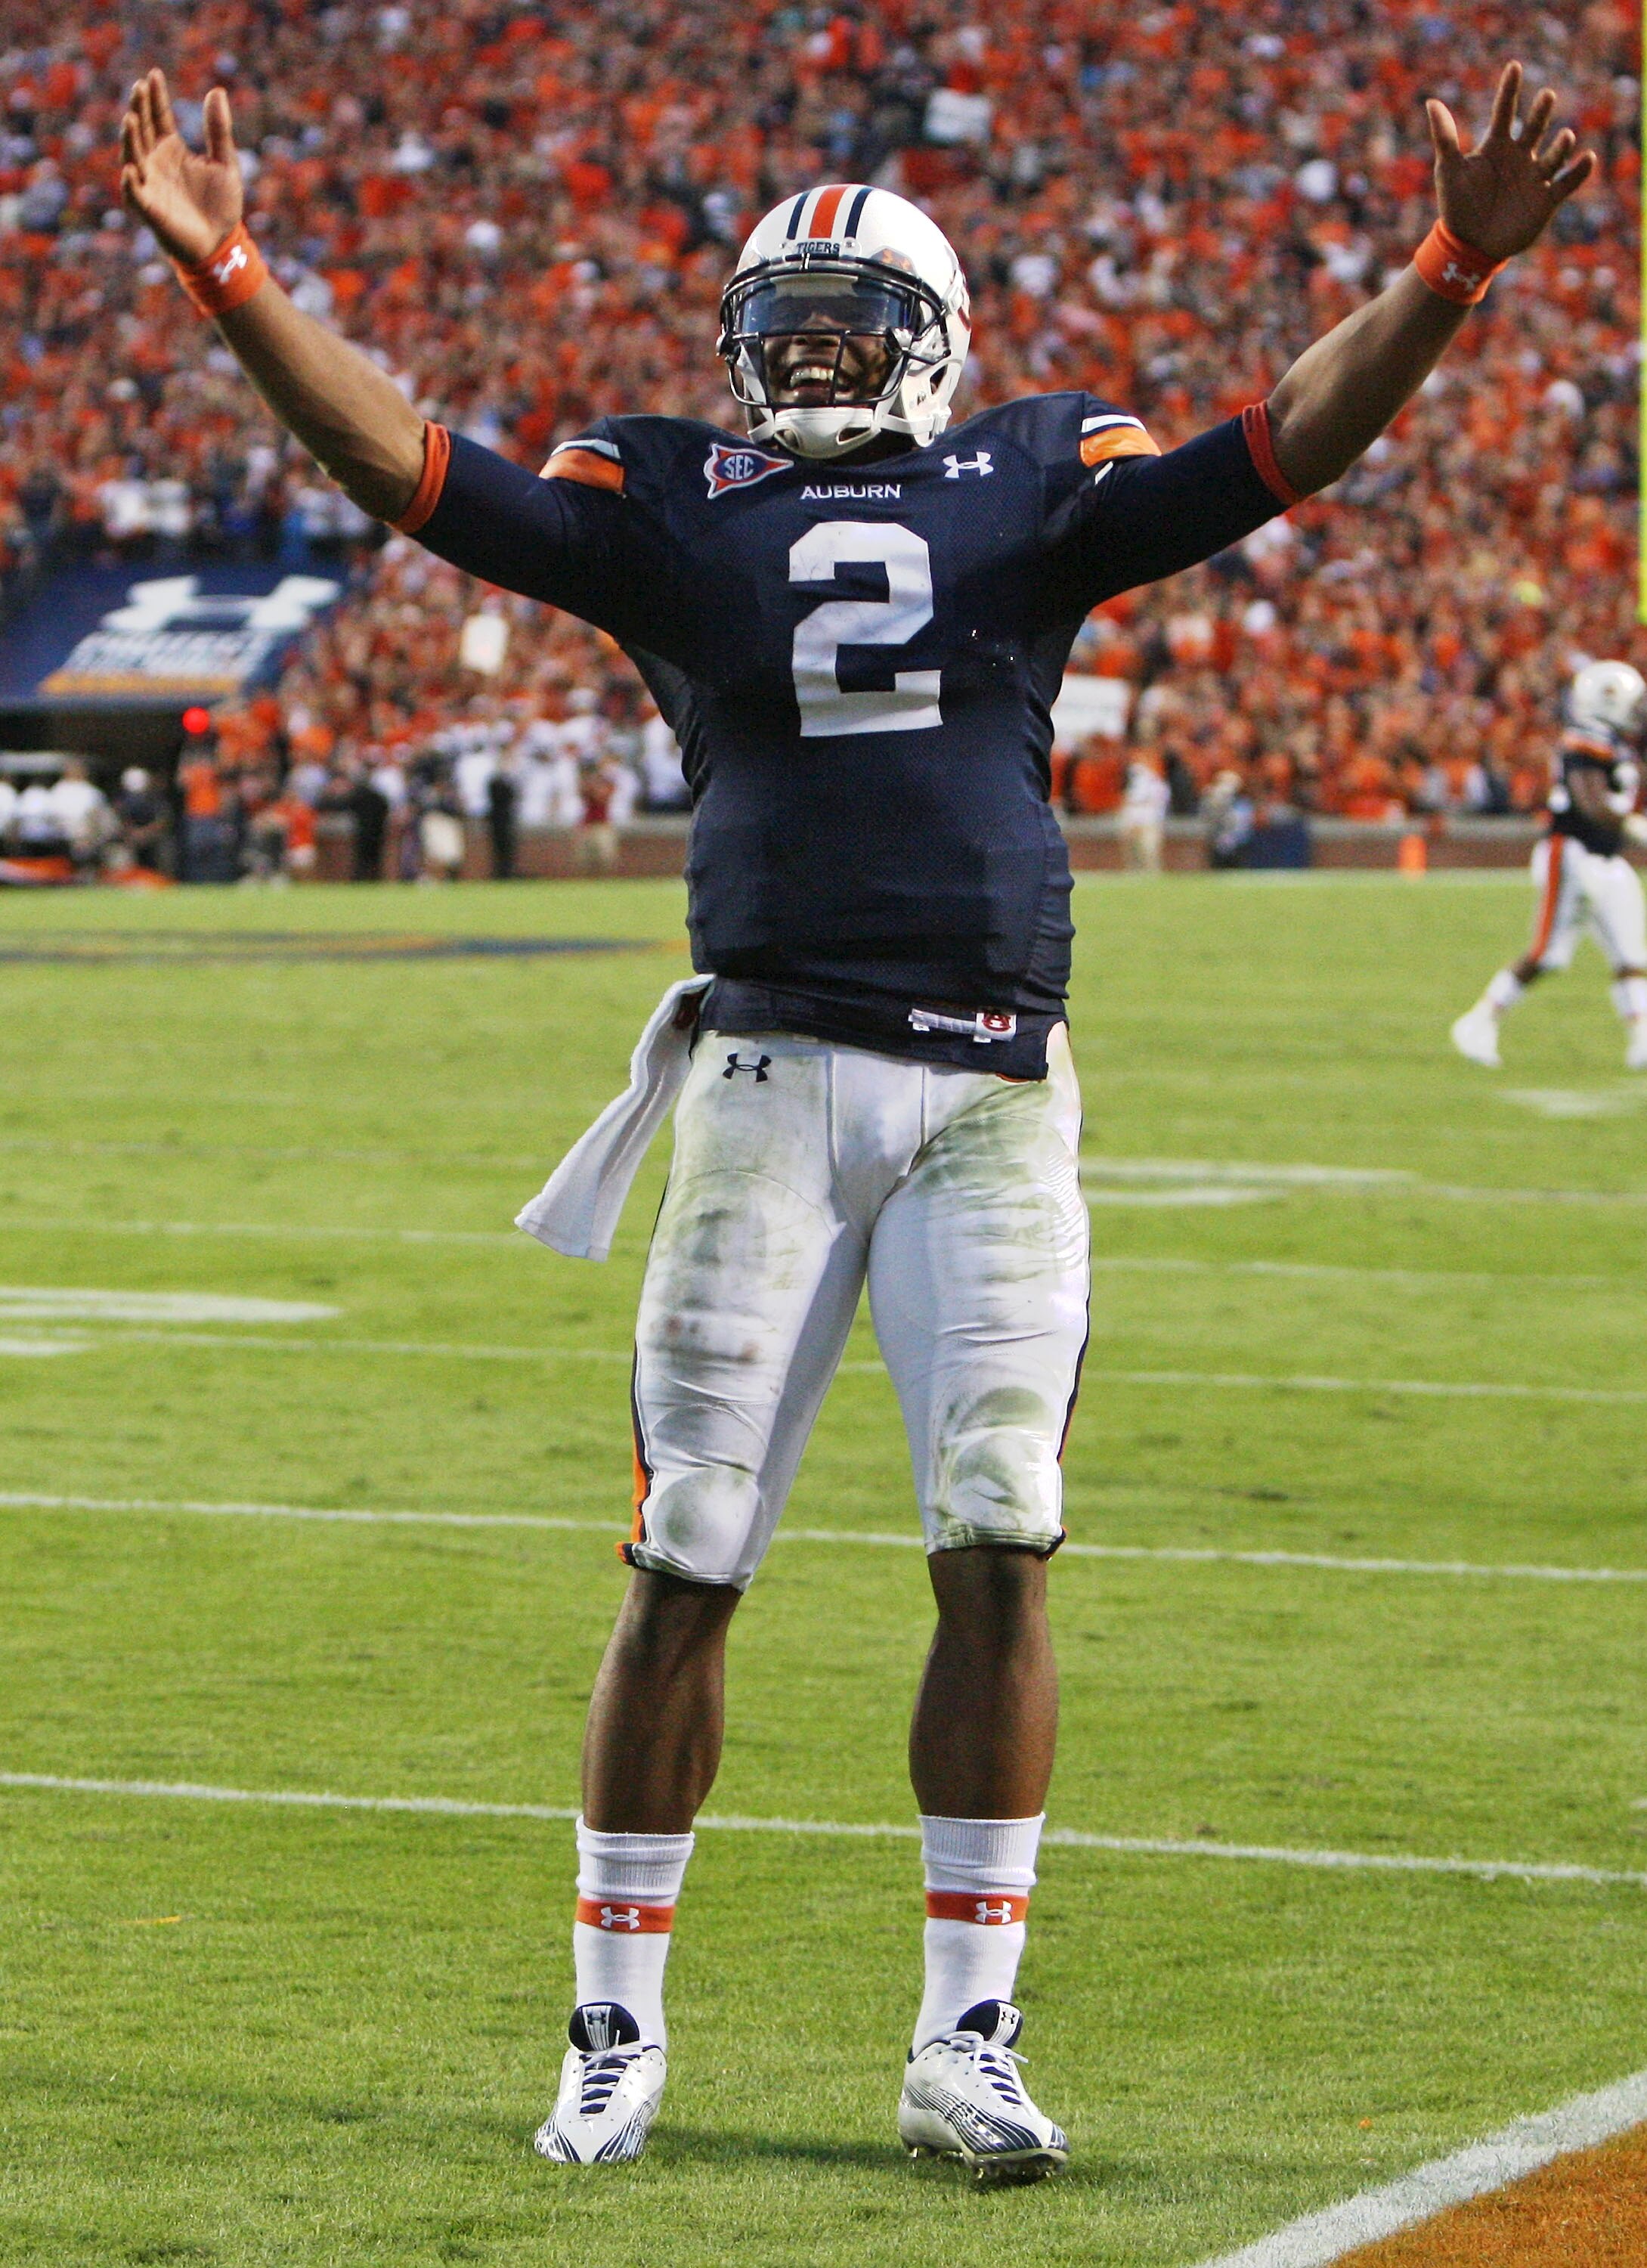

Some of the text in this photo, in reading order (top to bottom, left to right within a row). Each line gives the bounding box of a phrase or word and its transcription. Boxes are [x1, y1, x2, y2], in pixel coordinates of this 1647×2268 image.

[796, 241, 841, 255] TIGERS
[724, 455, 754, 480] SEC
[800, 485, 902, 500] AUBURN
[788, 520, 944, 738] 2
